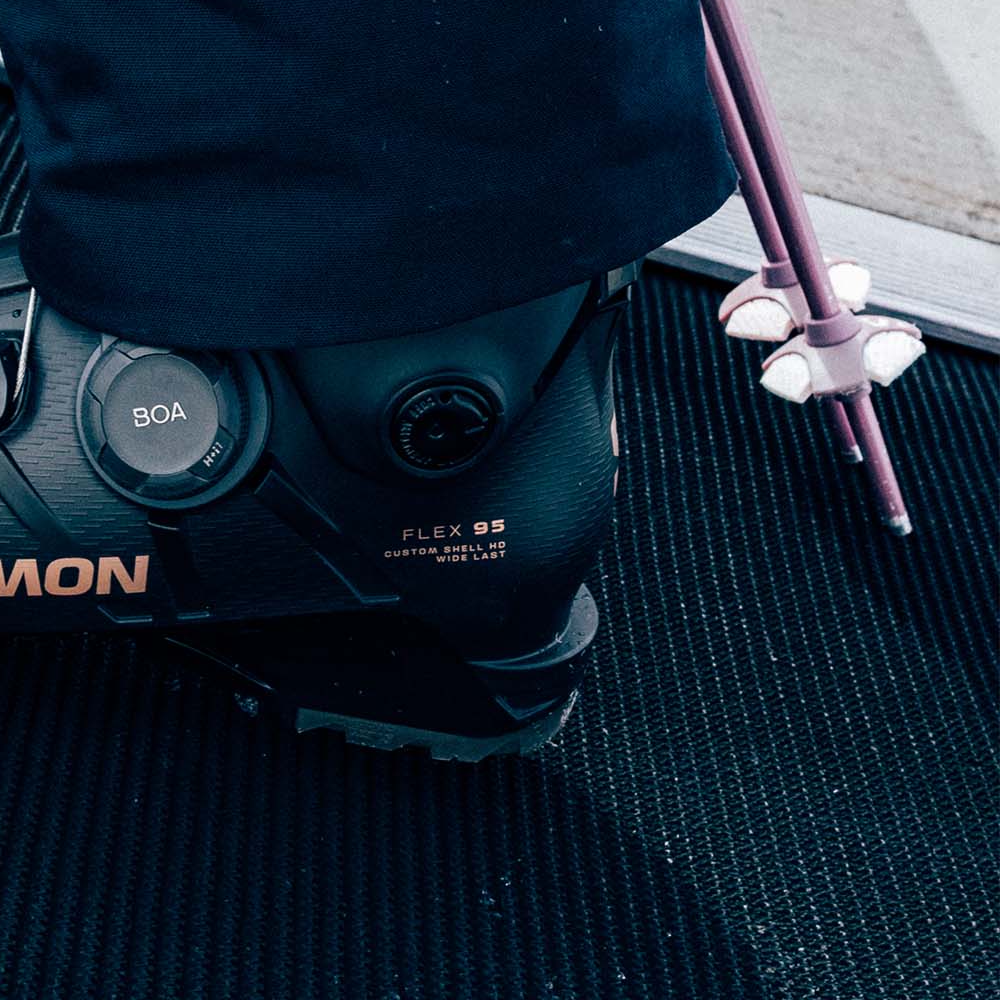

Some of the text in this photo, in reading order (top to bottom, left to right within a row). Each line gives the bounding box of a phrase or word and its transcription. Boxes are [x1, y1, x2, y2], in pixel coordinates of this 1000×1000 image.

[132, 401, 187, 428] BOA
[402, 519, 505, 540] FLEX 95
[384, 541, 506, 558] CUSTOM SHELL HD
[436, 550, 506, 563] WIDE LAST
